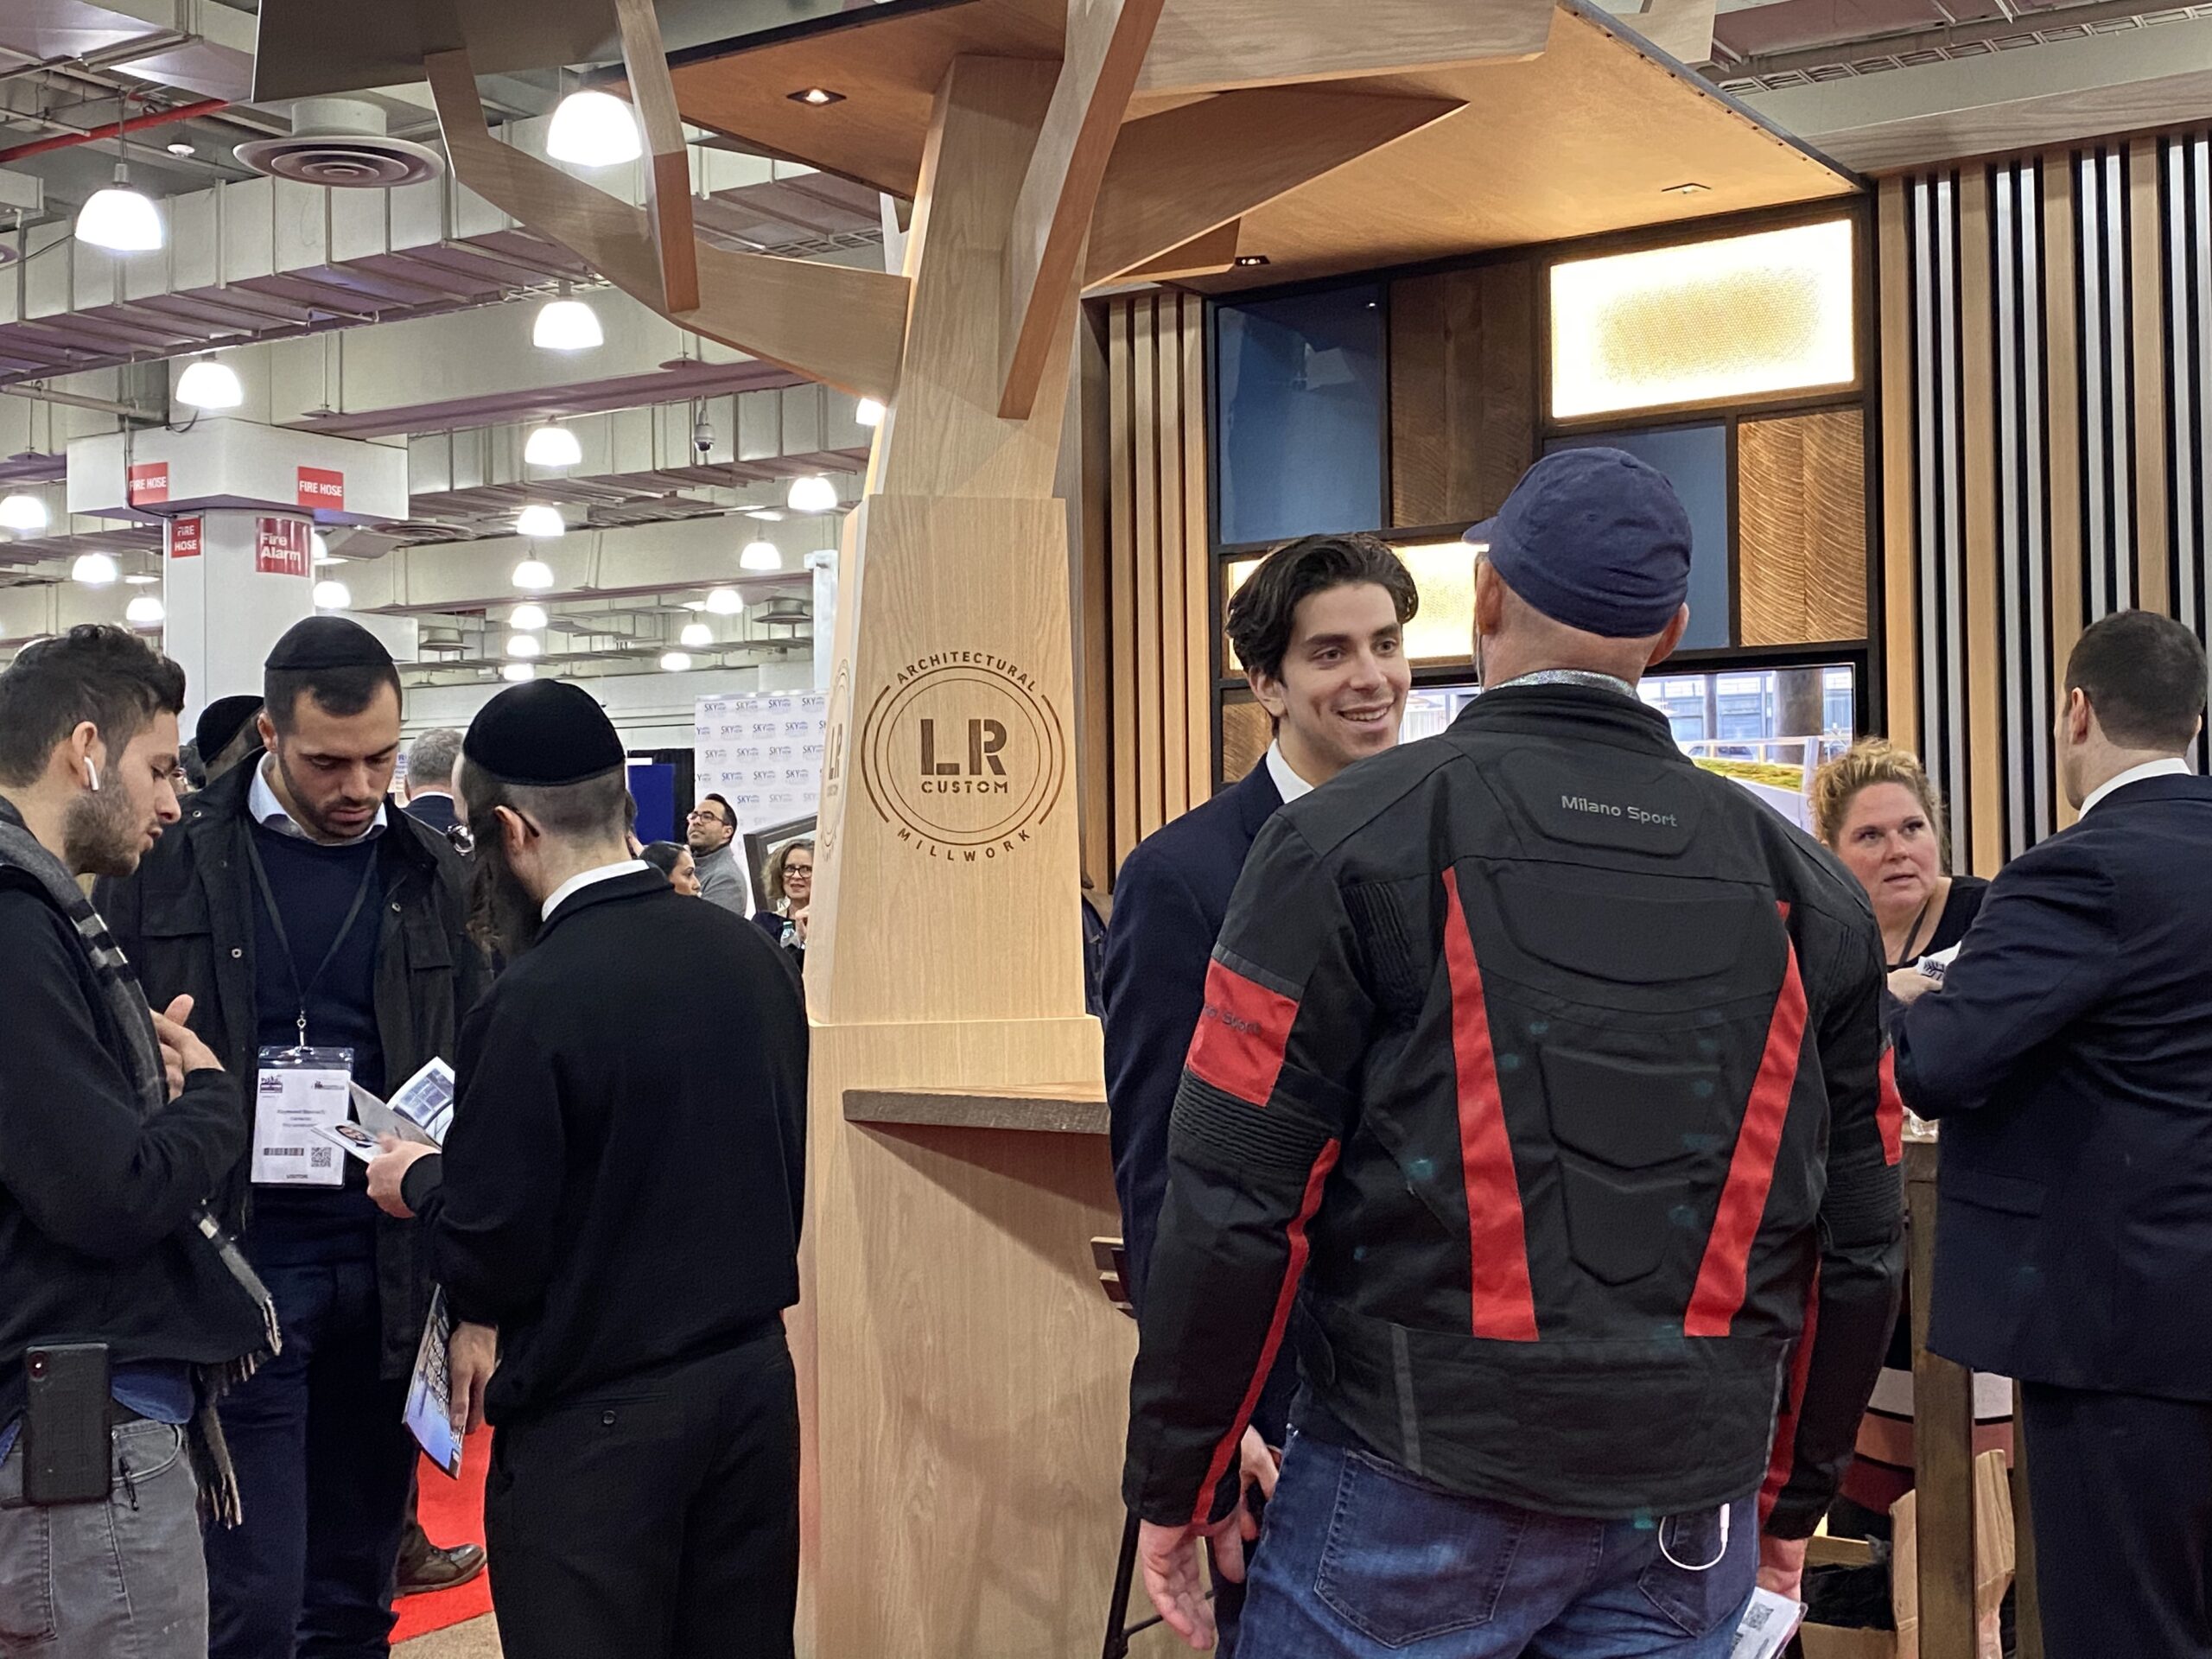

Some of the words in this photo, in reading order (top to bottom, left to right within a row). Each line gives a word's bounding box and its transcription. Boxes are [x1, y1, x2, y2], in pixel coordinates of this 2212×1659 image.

[130, 479, 145, 491] FIRE
[147, 476, 166, 488] HOSE
[299, 480, 318, 493] FIRE
[320, 484, 342, 496] HOSE
[177, 524, 194, 536] FIRE
[175, 539, 197, 551] HOSE
[261, 532, 287, 545] Fire
[261, 546, 301, 561] Alarm
[896, 651, 1036, 691] ARCHITECTURAL
[920, 719, 1007, 776] LR
[921, 781, 1008, 793] CUSTOM
[1561, 795, 1621, 817] Milano
[1627, 806, 1678, 827] Sport
[897, 828, 1030, 861] MILLWORK
